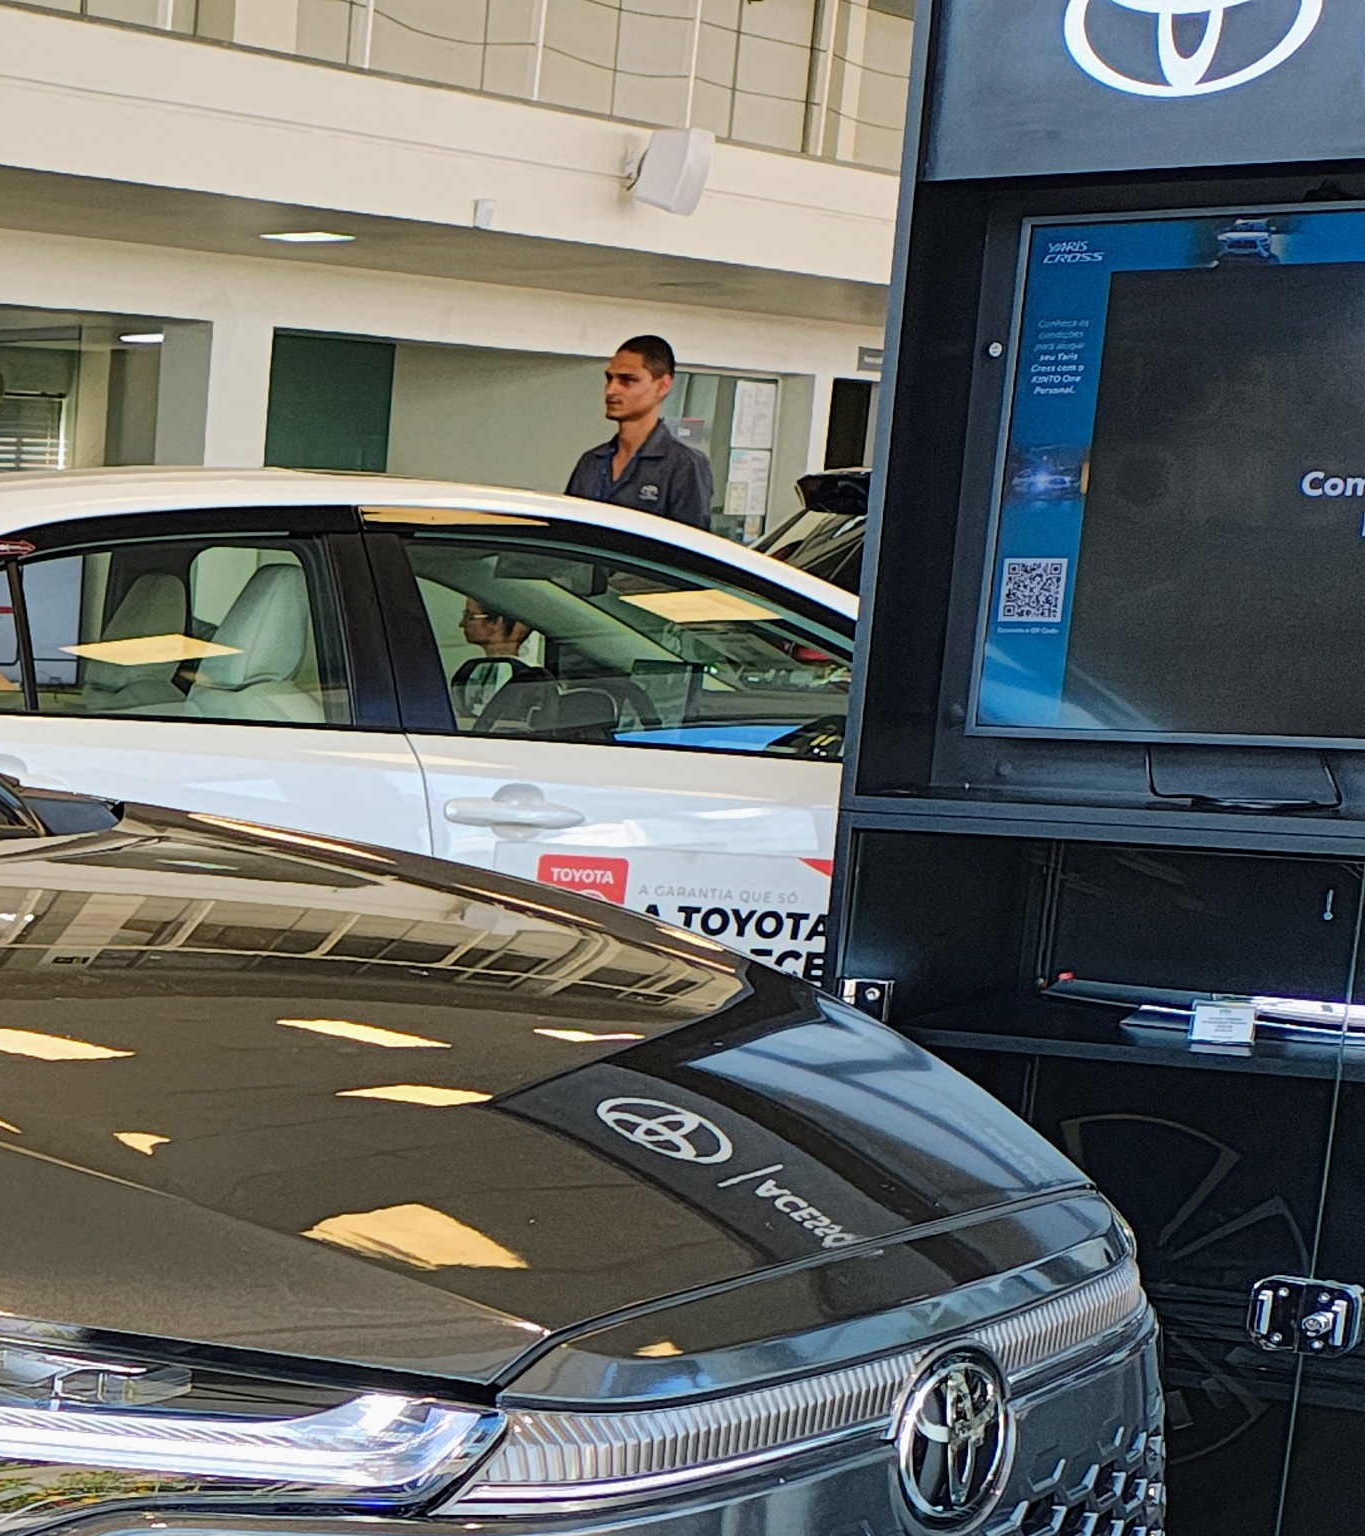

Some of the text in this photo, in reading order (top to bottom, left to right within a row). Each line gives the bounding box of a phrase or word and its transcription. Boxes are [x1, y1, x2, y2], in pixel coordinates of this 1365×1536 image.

[1048, 240, 1089, 252] YARIS
[1042, 251, 1105, 264] CROSS
[1057, 352, 1078, 361] Yaris
[1031, 364, 1056, 373] Cross
[551, 867, 614, 885] TOYOTA
[638, 884, 799, 904] A GARANTIA QUE SÓ
[677, 905, 826, 941] TOYOTA
